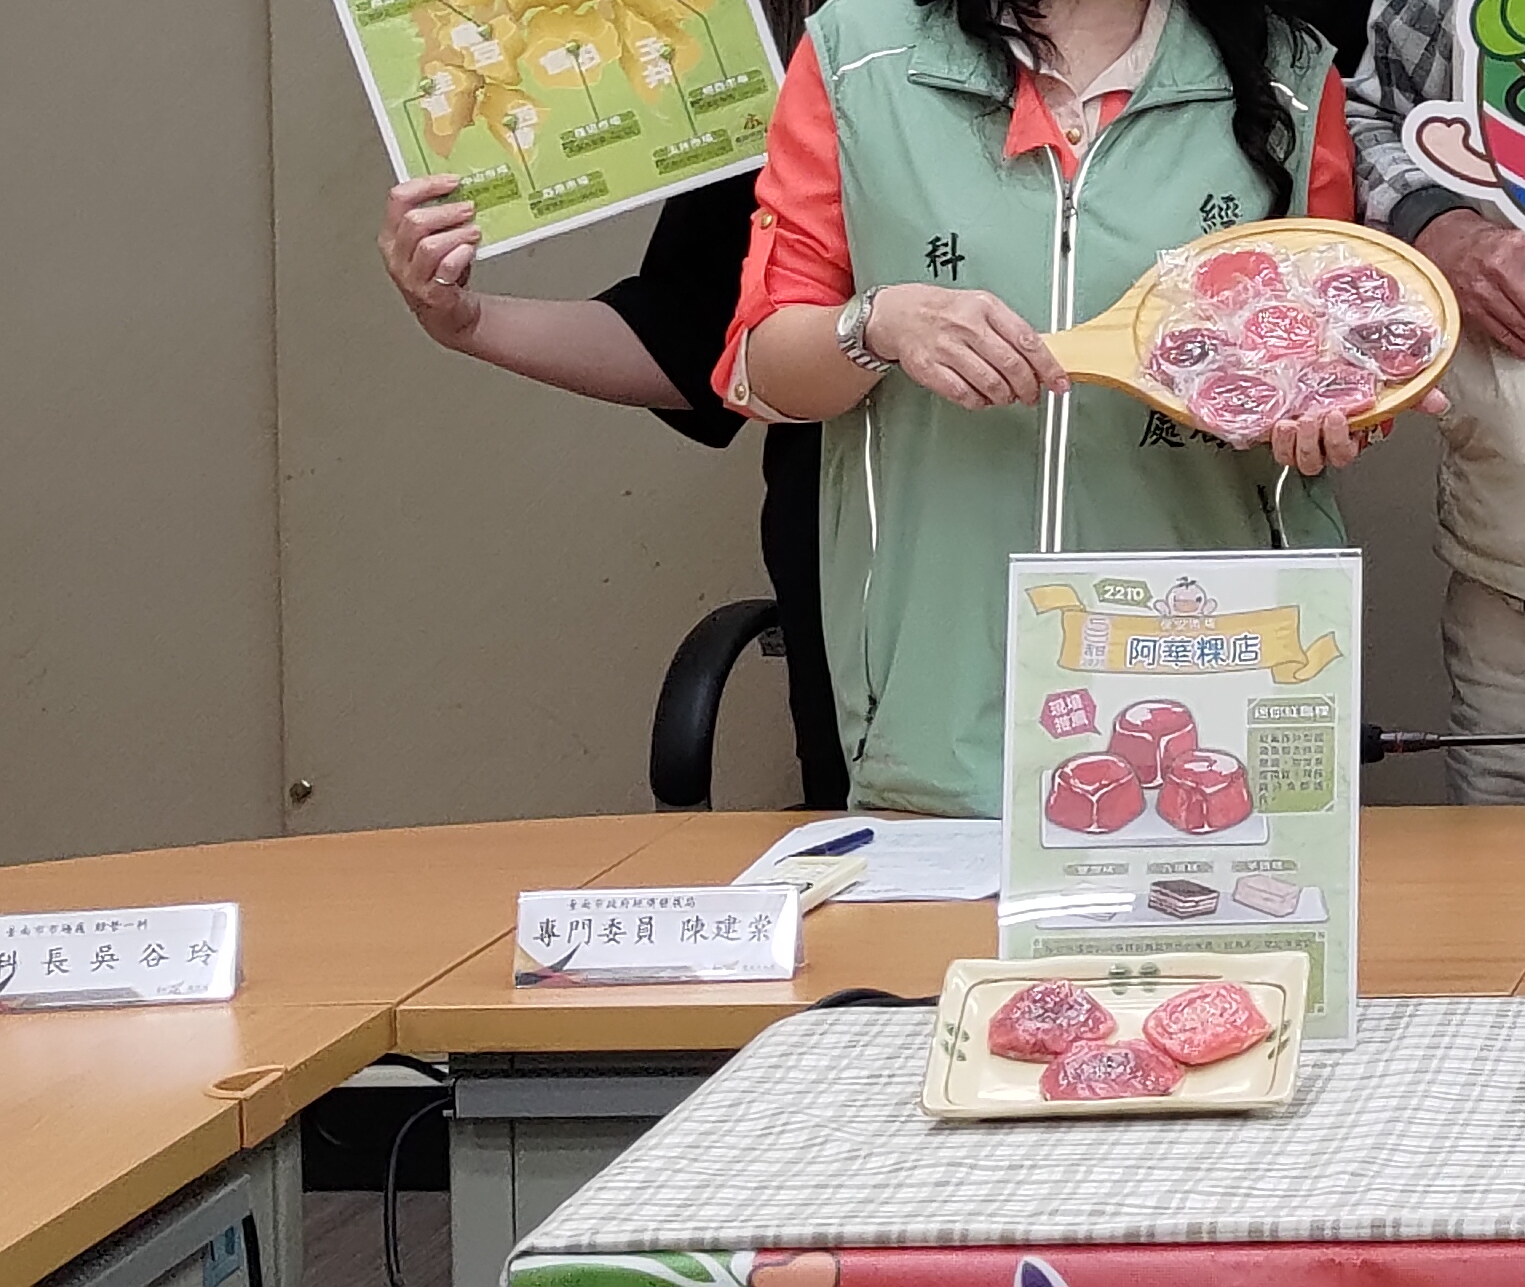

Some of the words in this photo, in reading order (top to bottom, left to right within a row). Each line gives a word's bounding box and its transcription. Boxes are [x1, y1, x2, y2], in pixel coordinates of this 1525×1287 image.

[925, 232, 965, 281] 科
[1128, 634, 1261, 668] 阿華粿店
[532, 915, 655, 947] 專門委員
